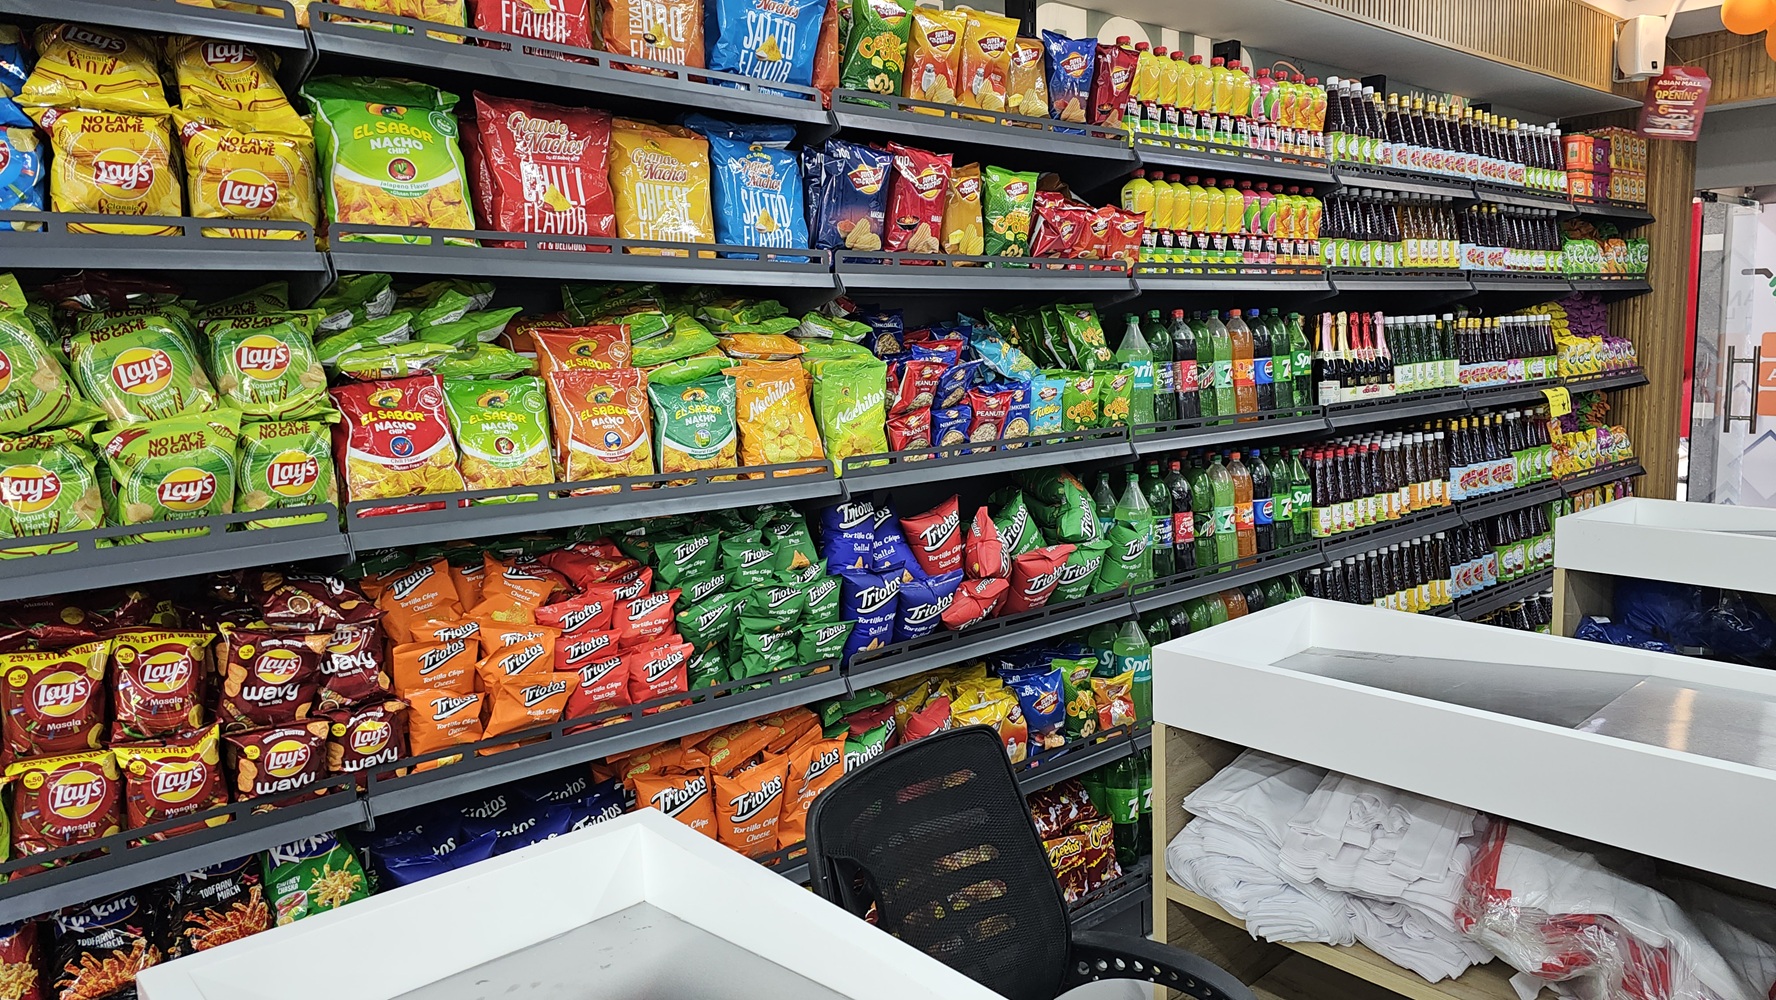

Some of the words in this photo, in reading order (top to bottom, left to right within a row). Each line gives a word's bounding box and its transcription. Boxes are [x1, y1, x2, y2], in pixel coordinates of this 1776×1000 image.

[502, 2, 566, 44] FLAVOR
[743, 10, 796, 59] SALTED
[739, 50, 792, 83] FLAVOR
[1655, 90, 1698, 100] OPENING
[80, 124, 98, 133] NO
[100, 124, 144, 132] GAME
[82, 116, 100, 124] NO
[102, 116, 142, 124] LAY'S
[508, 111, 569, 136] Grande
[353, 126, 375, 140] EL
[376, 122, 434, 144] SABOR
[217, 144, 234, 153] NO
[236, 145, 275, 156] GAME
[370, 136, 424, 150] NACHO
[388, 147, 410, 155] CHIPS
[99, 161, 151, 189] Lay's
[644, 165, 688, 182] Nachos
[223, 183, 276, 208] Lay's
[636, 182, 690, 221] CHEESE
[741, 189, 791, 228] SALTED
[524, 203, 588, 236] FLAVOR
[743, 226, 793, 249] FLAVOR
[91, 332, 110, 345] NO
[112, 320, 148, 337] GAME
[241, 345, 287, 371] Lay's
[577, 358, 612, 370] SABOR
[118, 353, 168, 389] Lay's
[250, 381, 277, 390] Yogurt
[260, 388, 279, 396] Herb
[141, 390, 168, 406] Yogurt
[152, 399, 174, 411] Herb
[749, 377, 796, 422] Nachitos
[361, 413, 378, 427] EL
[379, 410, 425, 422] SABOR
[469, 414, 482, 425] EL
[482, 410, 527, 424] SABOR
[581, 407, 593, 421] EL
[593, 404, 629, 417] SABOR
[675, 407, 686, 421] EL
[687, 404, 722, 415] SABOR
[836, 388, 885, 432] Nachitos
[259, 424, 277, 432] NO
[375, 422, 416, 433] NACHO
[482, 423, 519, 431] NACHO
[591, 417, 624, 426] NACHO
[685, 415, 717, 425] NACHO
[259, 430, 277, 439] NO
[278, 426, 310, 436] GAME
[902, 424, 929, 437] PEANUTS
[148, 447, 168, 458] NO
[170, 438, 206, 454] GAME
[149, 438, 169, 449] NO
[170, 431, 204, 445] LAY'S
[272, 457, 316, 486] Lay's
[162, 474, 212, 504] Lay's
[16, 514, 46, 523] Yogurt
[25, 521, 49, 530] Herb
[920, 509, 960, 551] Triotos
[674, 535, 709, 565] Triotos
[873, 546, 895, 561] Salted
[1024, 563, 1067, 595] Triotos
[1058, 556, 1100, 585] Triotos
[502, 580, 524, 593] Tortilla
[524, 588, 541, 597] Chips
[510, 590, 531, 602] Cheese
[692, 574, 725, 602] Triotos
[807, 580, 837, 607] Triotos
[855, 576, 900, 613] Triotos
[400, 597, 421, 608] Tortilla
[422, 592, 438, 601] Chips
[413, 601, 434, 612] Cheese
[904, 592, 954, 624] Triotos
[559, 601, 602, 633] Triotos
[654, 618, 668, 626] Chips
[869, 624, 888, 635] Salted
[904, 624, 928, 632] Tortilla
[118, 634, 140, 643] 25%
[141, 632, 175, 644] EXTRA
[9, 653, 35, 662] 25%
[36, 650, 72, 660] EXTRA
[73, 641, 105, 654] VALUE
[418, 639, 465, 675] Triotos
[565, 634, 609, 664] Triotos
[320, 651, 376, 675] wavy
[498, 643, 544, 674] Triotos
[643, 651, 684, 683] Triotos
[10, 674, 27, 682] Rs.50
[143, 659, 188, 683] Lay's
[422, 672, 446, 684] Tortilla
[447, 668, 465, 677] Chips
[433, 678, 455, 688] Cheese
[584, 685, 606, 696] Tortilla
[606, 681, 621, 690] Chips
[649, 681, 670, 691] Tortilla
[38, 680, 86, 706] Lay's
[242, 683, 301, 701] wavy
[520, 680, 566, 707] Triotos
[150, 696, 183, 706] Masala
[47, 719, 81, 731] Masala
[436, 720, 459, 730] Tortilla
[447, 726, 468, 737] Cheese
[353, 726, 389, 748] Lay's
[127, 747, 152, 755] 25%
[153, 747, 188, 755] EXTRA
[268, 748, 307, 771] Lay's
[343, 747, 398, 773] wavy
[157, 766, 202, 795] Lay's
[53, 779, 102, 808] Lay's
[730, 776, 783, 823] Triotos
[165, 803, 198, 815] Masala
[62, 822, 97, 833] Masala
[691, 818, 709, 830] Chips
[733, 822, 761, 834] Tortilla
[763, 816, 778, 828] Chips
[746, 829, 771, 843] Cheese
[1050, 840, 1080, 867] Cheetos
[199, 878, 233, 899] TOOFAANI
[276, 876, 300, 888] CHUTNEY
[278, 883, 299, 895] CHASKA
[217, 885, 242, 901] MIRCH
